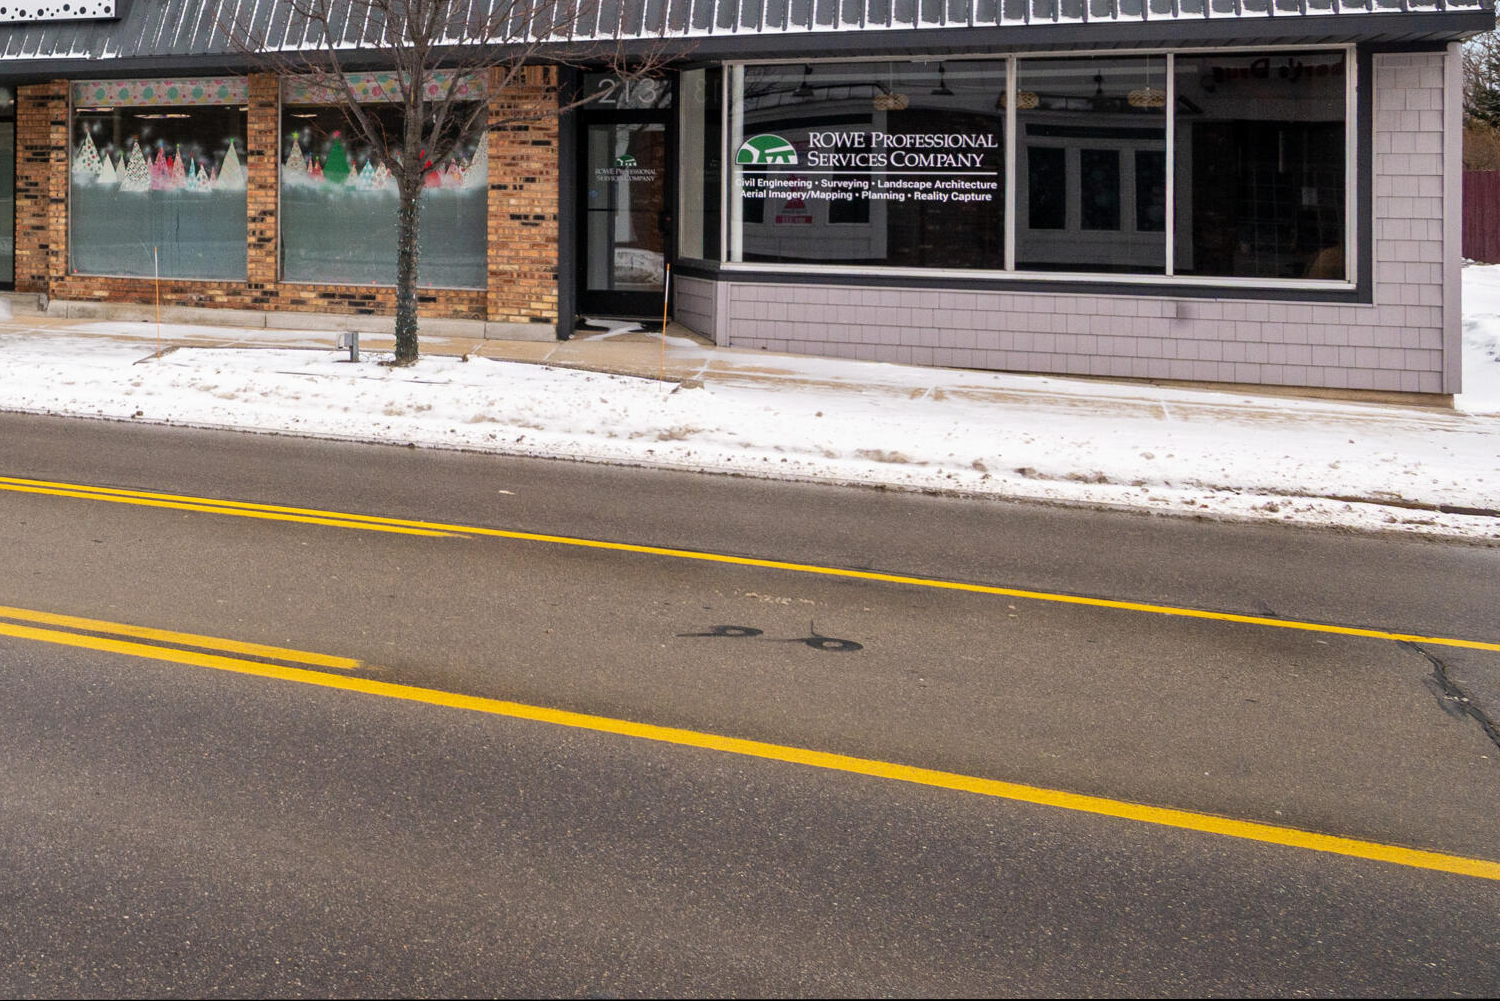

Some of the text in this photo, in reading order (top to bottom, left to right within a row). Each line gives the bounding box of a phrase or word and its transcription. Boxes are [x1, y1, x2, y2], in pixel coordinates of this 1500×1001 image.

[598, 78, 656, 103] 213
[808, 132, 998, 148] ROWE PROFESSIONAL
[807, 151, 984, 167] SERVICES COMPANY
[757, 179, 812, 190] Engineering
[821, 179, 869, 190] Surveying
[877, 180, 932, 190] Landscape
[934, 180, 997, 189] Architecture
[740, 190, 992, 202] Aerial Imagery/Mapping Planning Reality Capture
